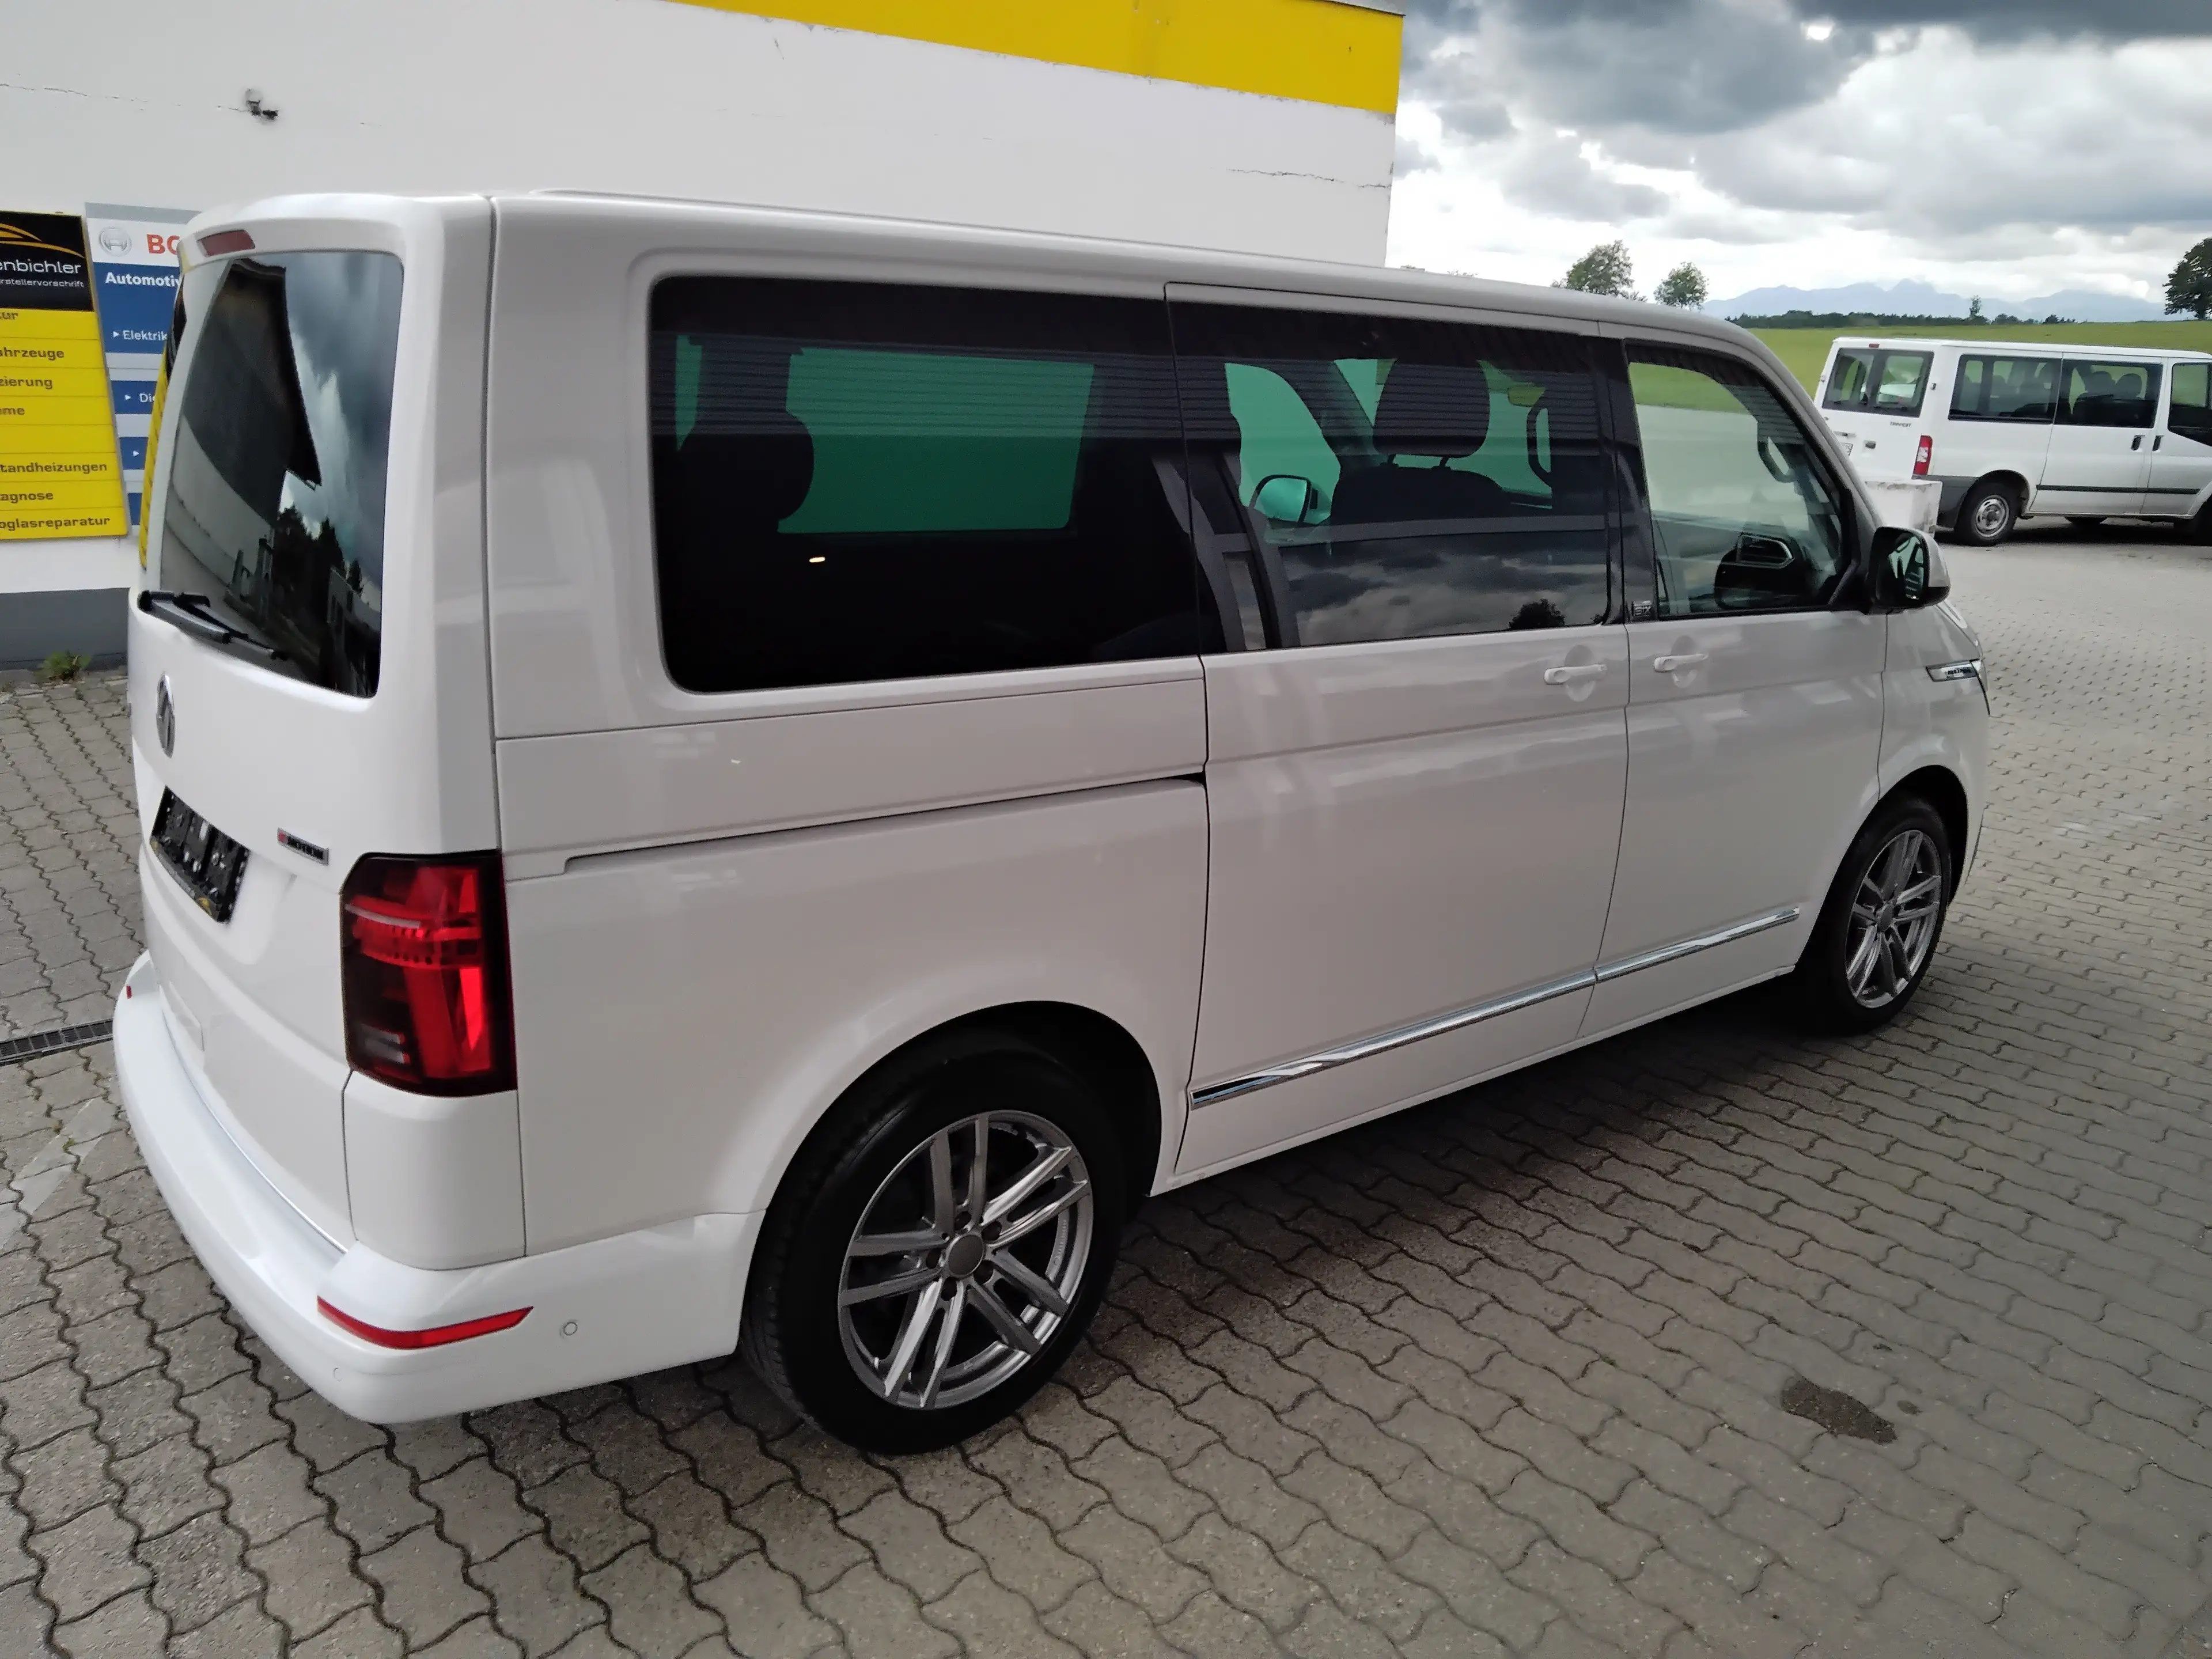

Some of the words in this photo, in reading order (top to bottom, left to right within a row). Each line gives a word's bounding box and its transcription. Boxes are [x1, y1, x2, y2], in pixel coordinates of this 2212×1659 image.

[0, 259, 81, 274] nbichler
[0, 312, 18, 320] ur
[0, 407, 25, 415] me
